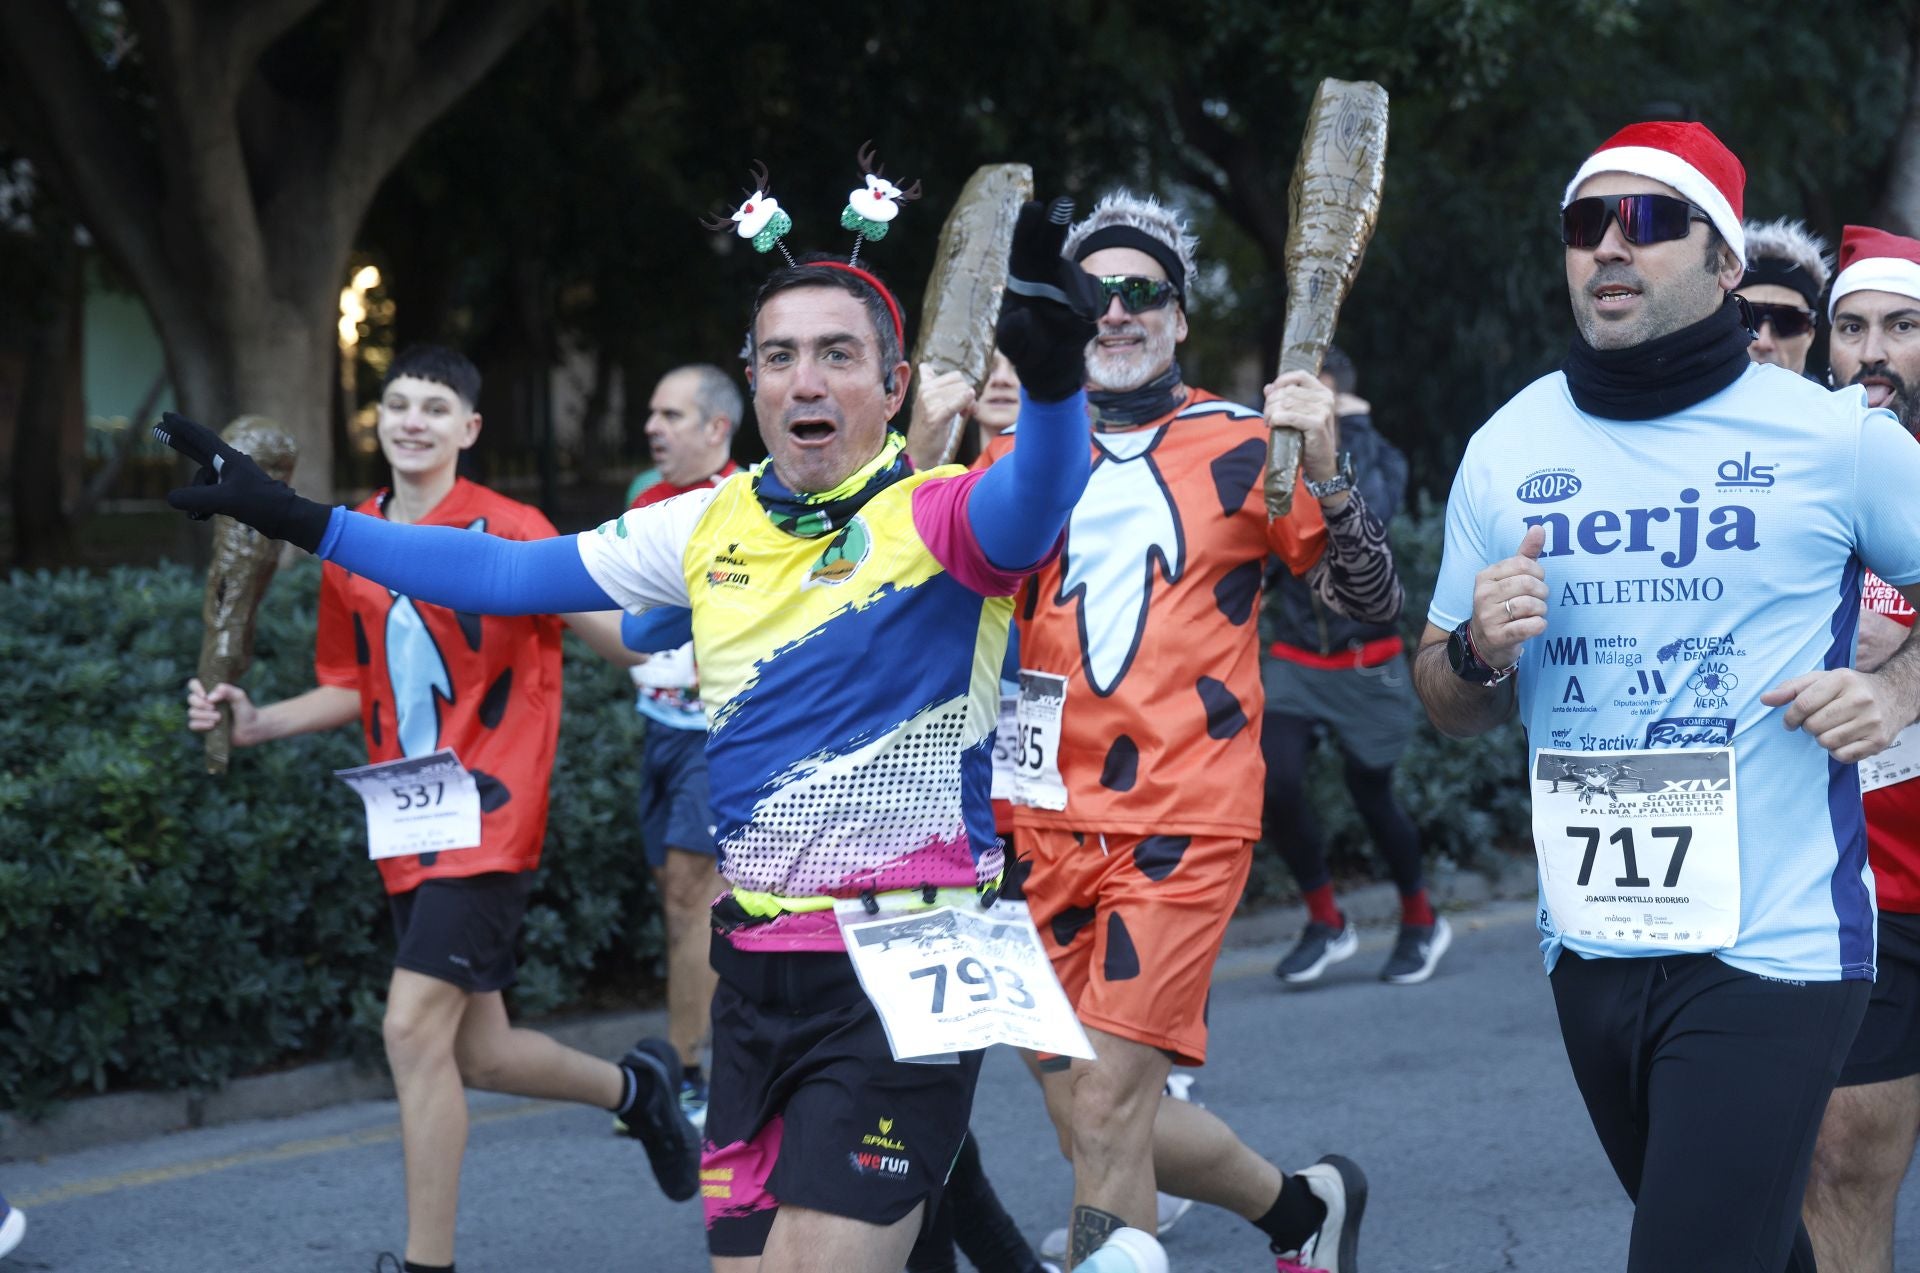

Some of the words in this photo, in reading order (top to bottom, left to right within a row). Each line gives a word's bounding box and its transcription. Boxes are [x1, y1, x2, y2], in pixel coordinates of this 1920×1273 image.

[1715, 451, 1775, 487] als
[1520, 475, 1579, 499] TROPS
[1523, 488, 1761, 568] nerja
[1559, 576, 1724, 607] ATLETISMO
[1594, 635, 1637, 648] metro
[1595, 651, 1642, 667] Málaga
[1552, 705, 1565, 713] Junta
[1566, 705, 1572, 713] de
[1613, 698, 1648, 707] Diputación
[1693, 697, 1728, 710] NERJA
[1682, 718, 1728, 727] COMERCIAL
[1650, 724, 1727, 748] Rogelia
[1658, 778, 1729, 792] XIV
[392, 781, 445, 811] 537
[1646, 792, 1724, 801] CARRERA
[1608, 801, 1637, 809] SAN
[1642, 799, 1724, 808] SILVESTRE
[1638, 805, 1725, 814] PALMILLA
[1566, 825, 1693, 888] 717
[1584, 895, 1617, 903] JOAQUIN
[1618, 895, 1654, 904] PORTILLO
[1655, 896, 1690, 904] RODRIGO
[909, 957, 1036, 1014] 793
